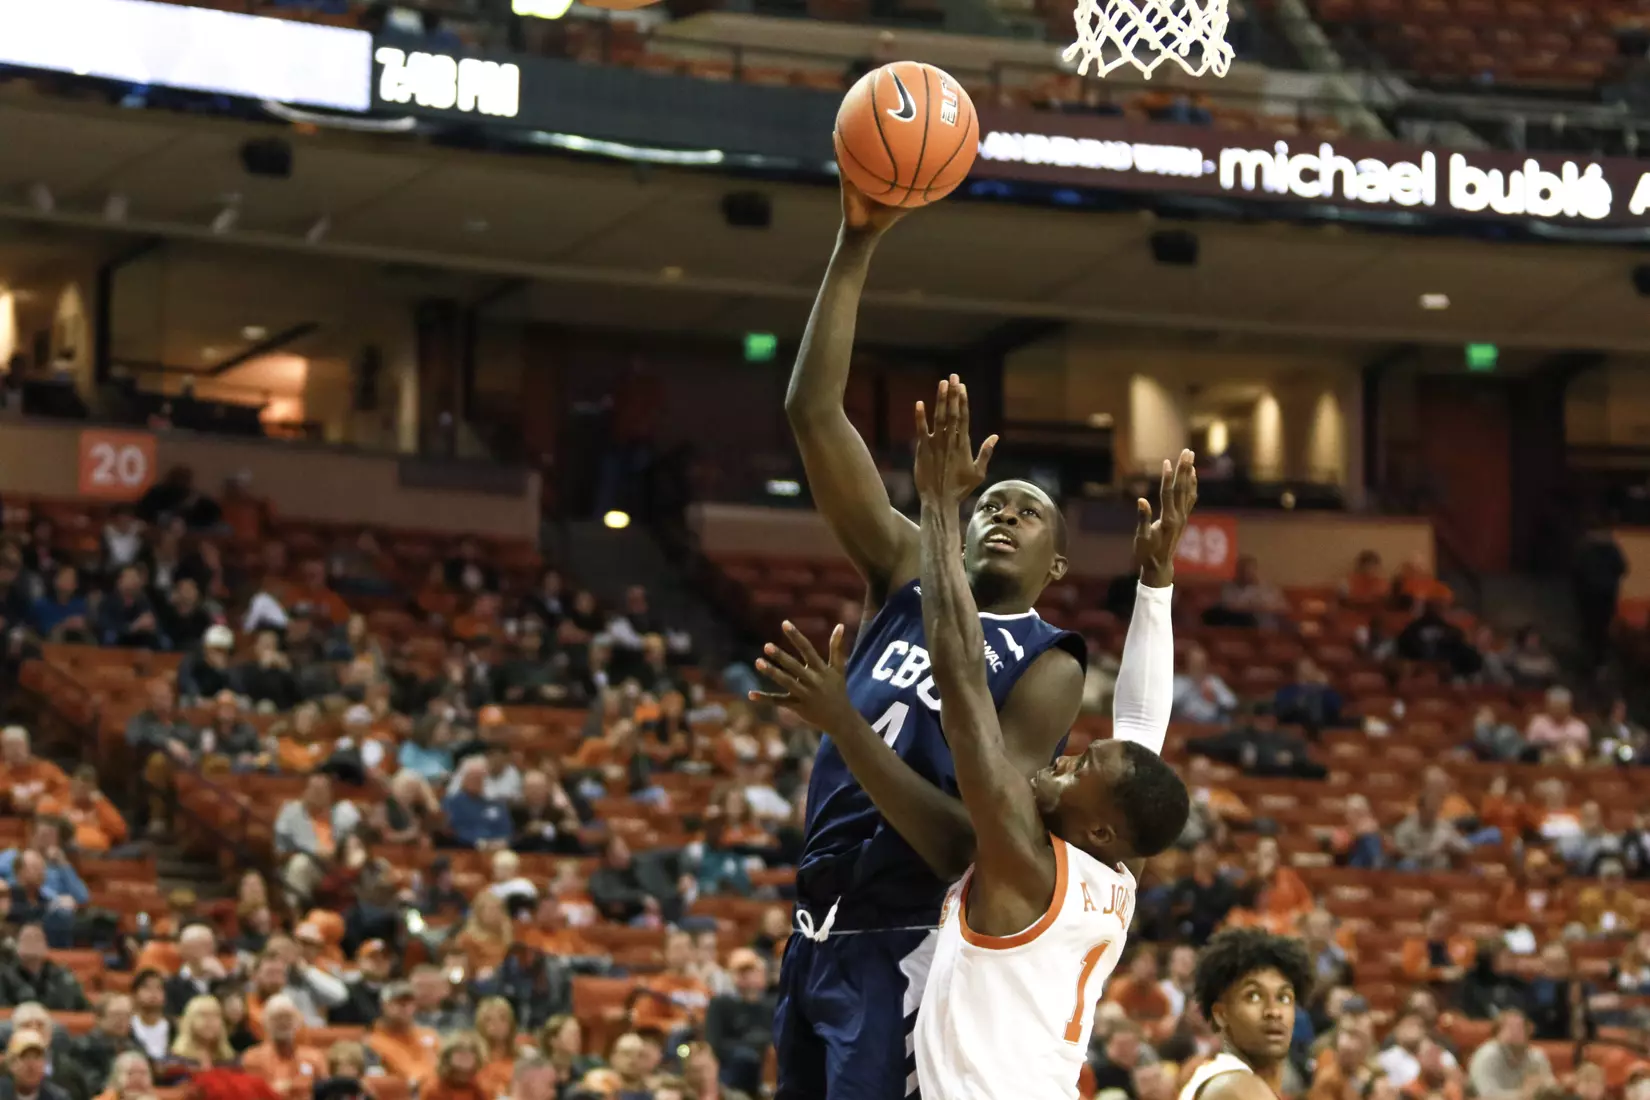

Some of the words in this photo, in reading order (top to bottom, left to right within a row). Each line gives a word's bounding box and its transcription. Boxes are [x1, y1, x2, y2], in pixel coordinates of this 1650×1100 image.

[1219, 140, 1436, 206] michael
[89, 443, 147, 488] 20
[1063, 940, 1111, 1046] 1
